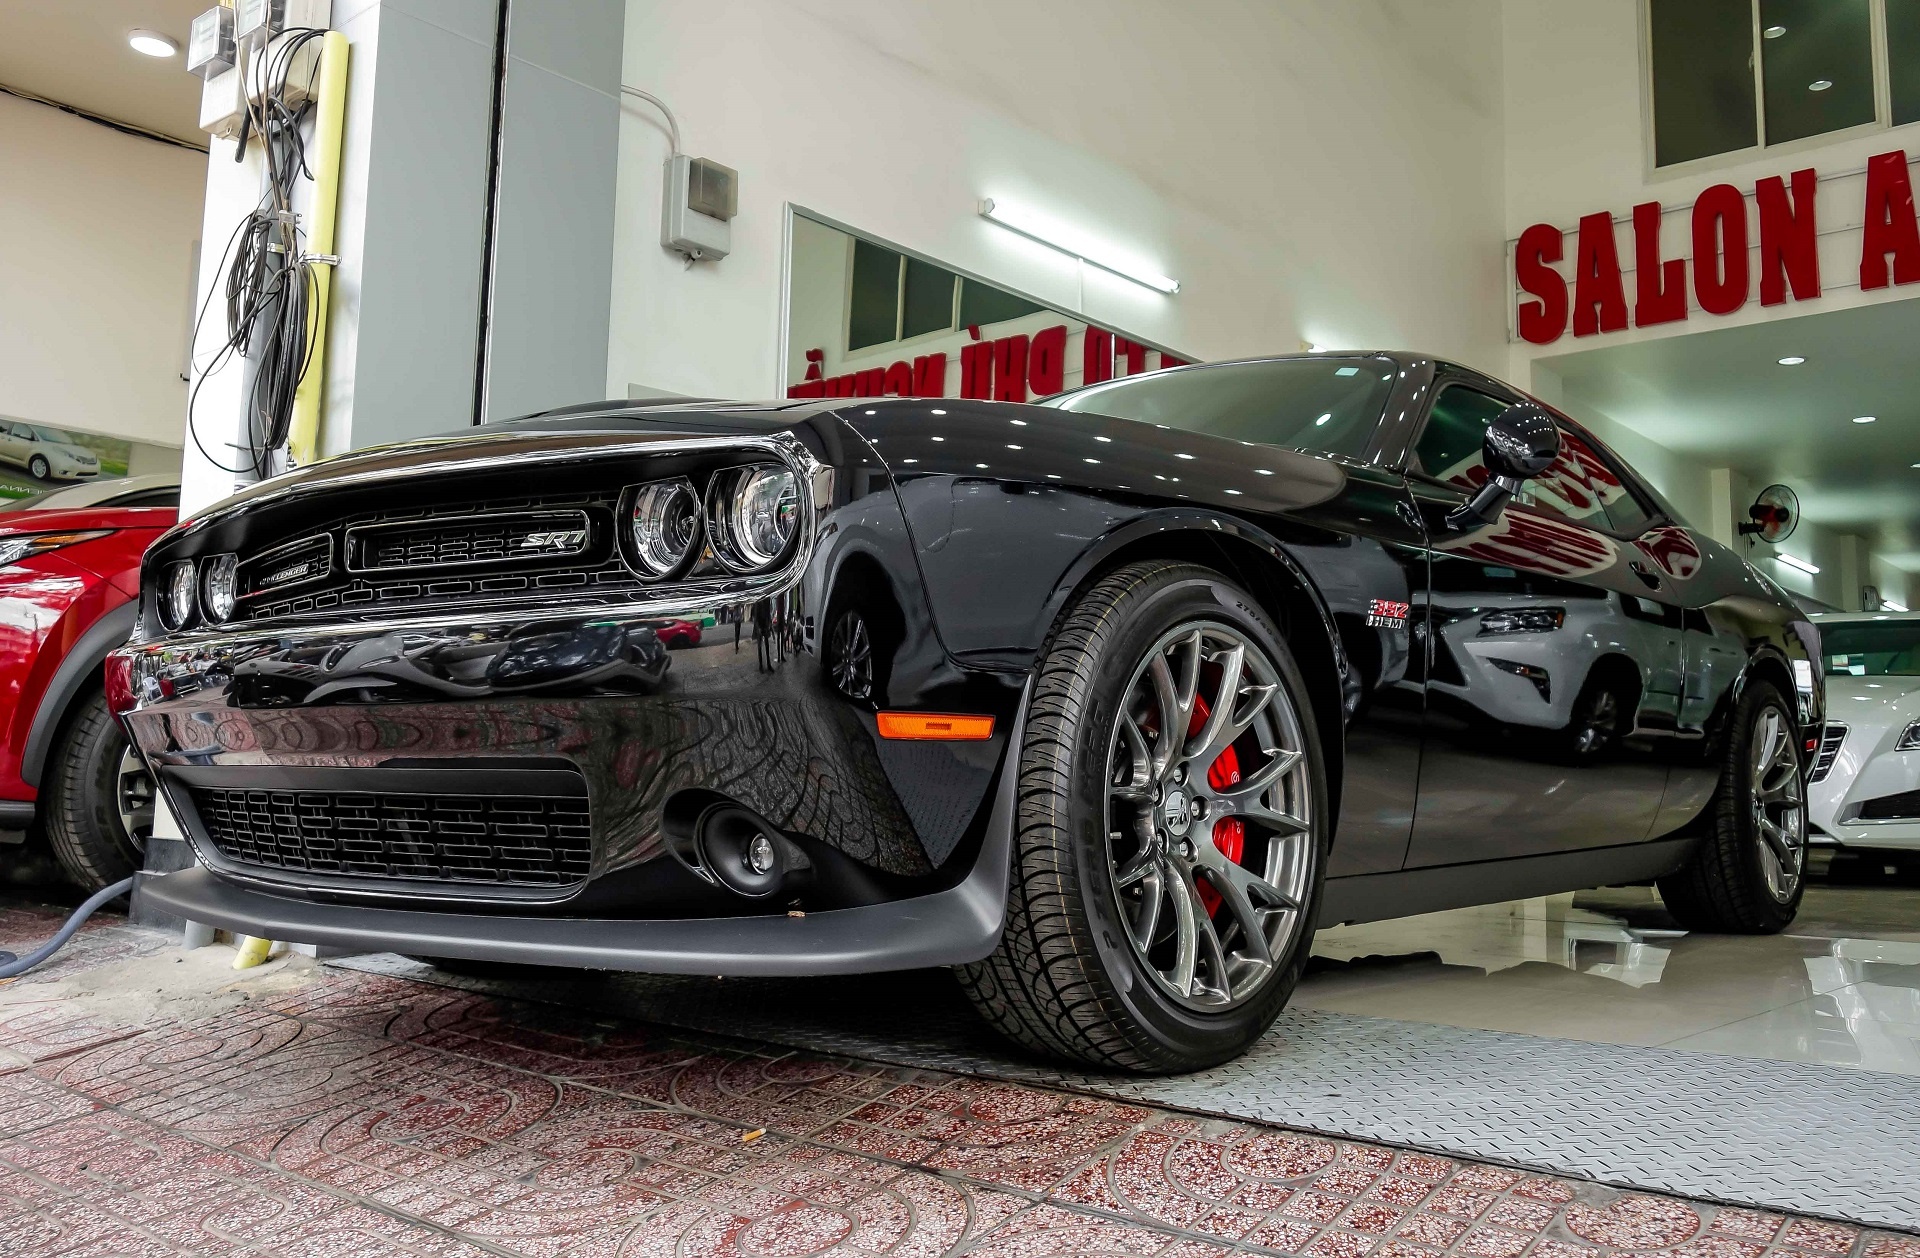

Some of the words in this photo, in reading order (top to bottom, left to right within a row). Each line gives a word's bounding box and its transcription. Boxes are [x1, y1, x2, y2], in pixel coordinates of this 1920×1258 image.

[1516, 168, 1822, 345] SALON
[1860, 149, 1920, 292] A
[520, 530, 586, 549] SRT
[1368, 599, 1409, 618] 392
[1366, 615, 1405, 629] HEMI
